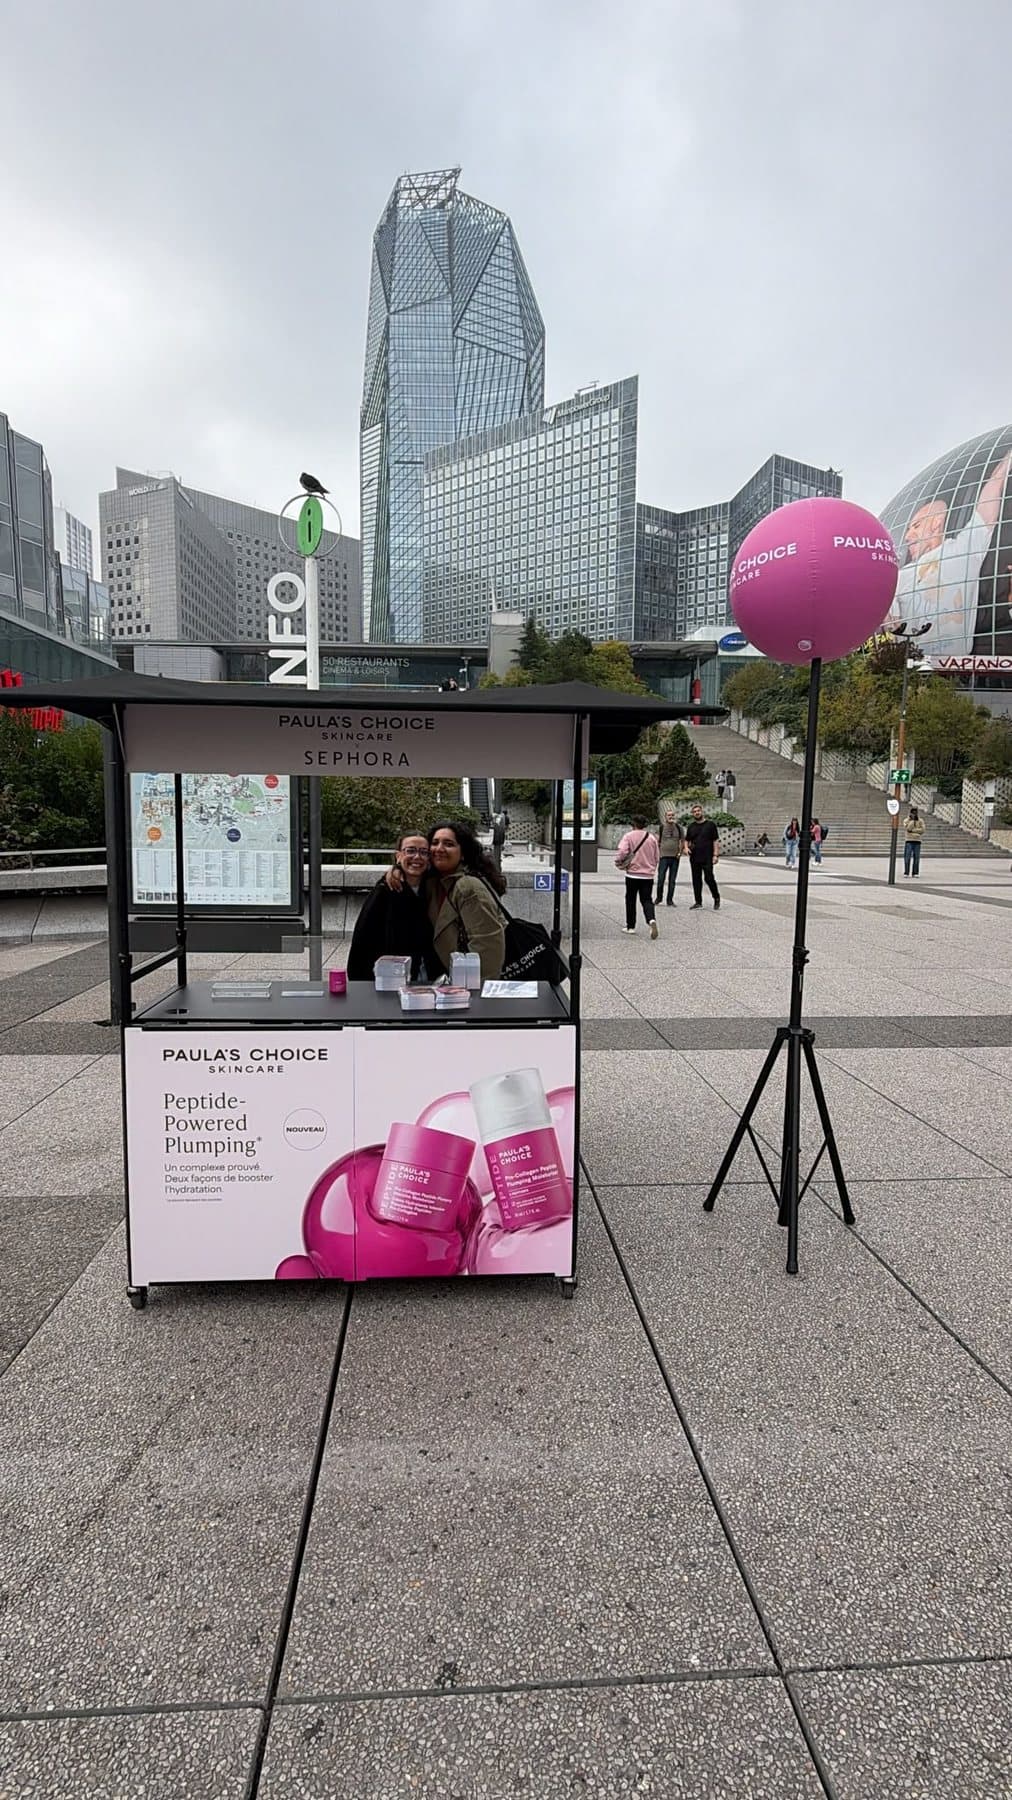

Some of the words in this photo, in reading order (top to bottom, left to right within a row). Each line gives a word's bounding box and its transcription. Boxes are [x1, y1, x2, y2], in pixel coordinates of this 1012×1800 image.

[833, 535, 892, 551] PAULA'S
[738, 543, 797, 573] CHOICE
[267, 571, 307, 684] NFO
[337, 656, 410, 668] RESTAURANTS
[278, 715, 352, 728] PAULA'S
[360, 716, 435, 730] CHOICE
[321, 732, 393, 741] SKINCARE
[304, 750, 410, 767] SEPHORA
[520, 944, 546, 964] CHOICE
[163, 1048, 241, 1062] PAULA'S
[250, 1048, 329, 1062] CHOICE
[208, 1065, 284, 1074] SKINCARE
[164, 1092, 246, 1113] Peptide-
[164, 1114, 248, 1132] Powered
[499, 1145, 531, 1159] PAULA'S
[500, 1151, 533, 1165] CHOICE
[164, 1164, 178, 1172] Un
[179, 1163, 226, 1174] complexe
[399, 1165, 431, 1178] PAULA'S
[164, 1174, 189, 1184] Deux
[190, 1174, 222, 1184] façons
[223, 1174, 236, 1183] de
[237, 1173, 274, 1182] booster
[398, 1171, 430, 1184] CHOICE
[489, 1155, 512, 1220] PEPTIDE
